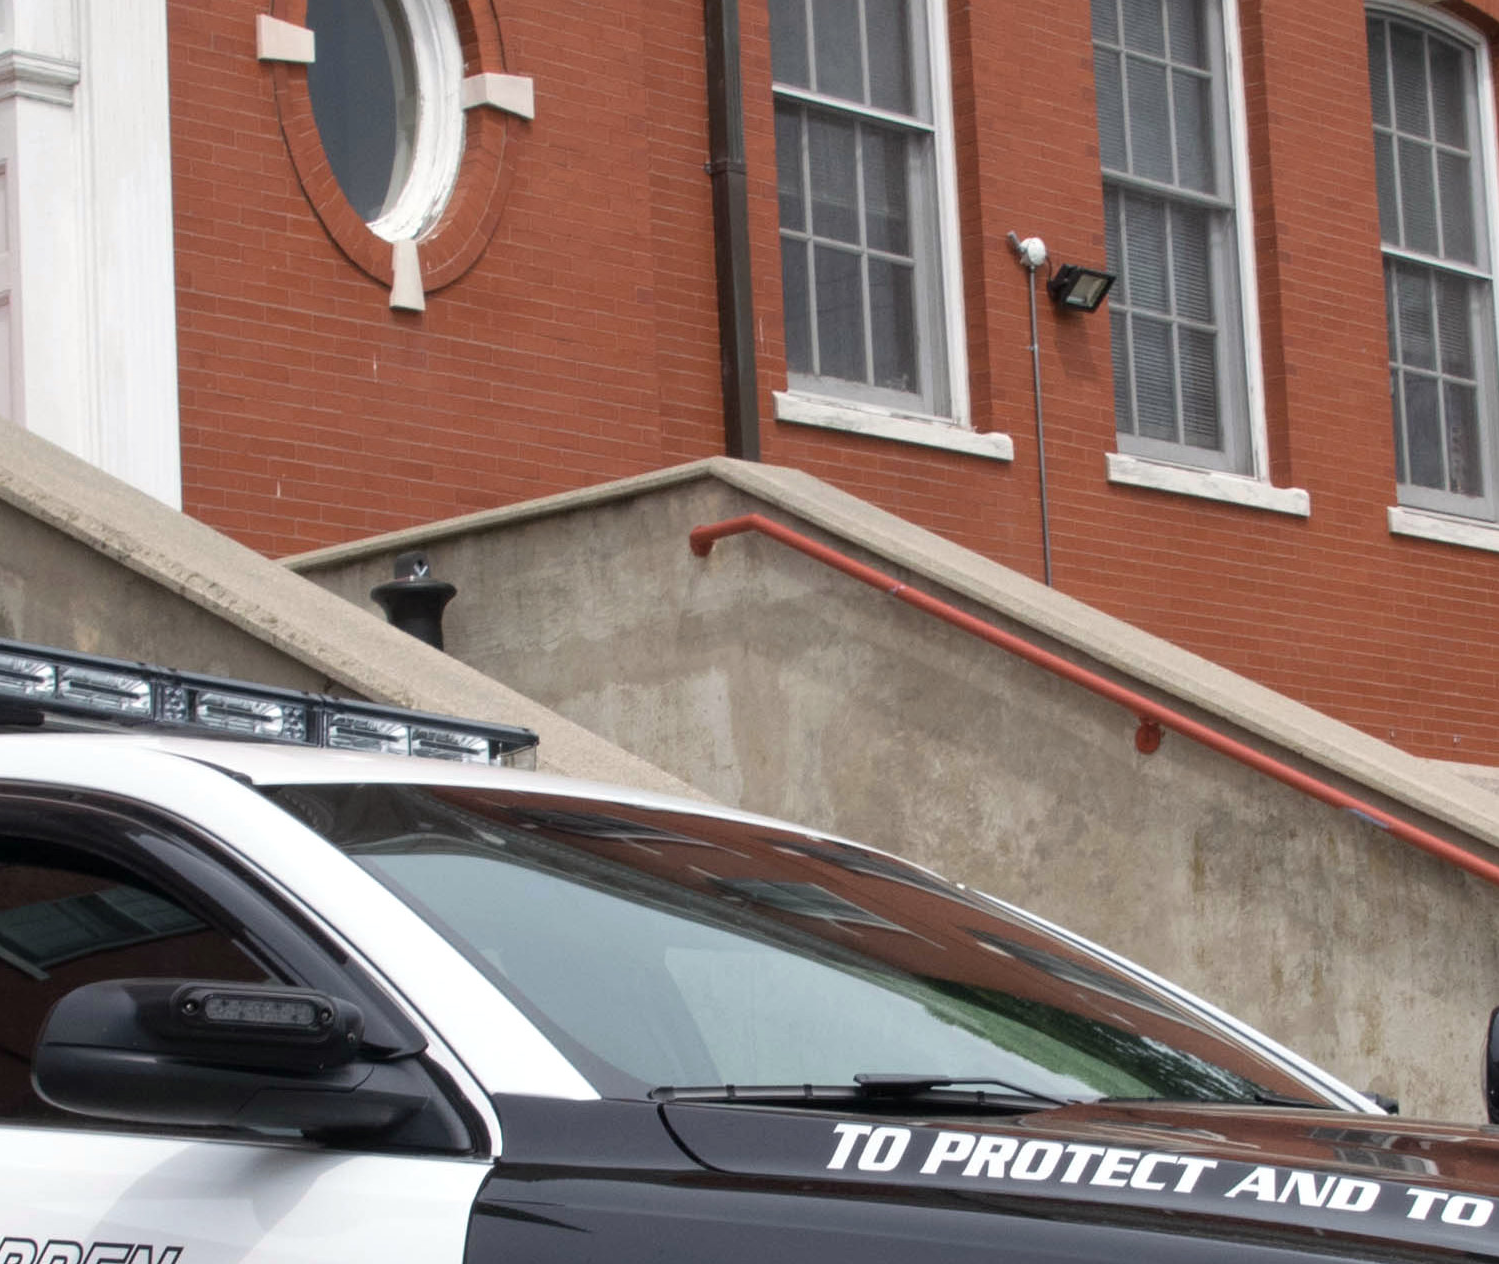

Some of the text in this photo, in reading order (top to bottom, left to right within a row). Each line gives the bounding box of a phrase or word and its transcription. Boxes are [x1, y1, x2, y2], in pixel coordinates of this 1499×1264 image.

[826, 1123, 912, 1171] TO
[919, 1128, 1218, 1194] PROTECT
[1224, 1167, 1382, 1213] AND
[1406, 1187, 1493, 1228] TO
